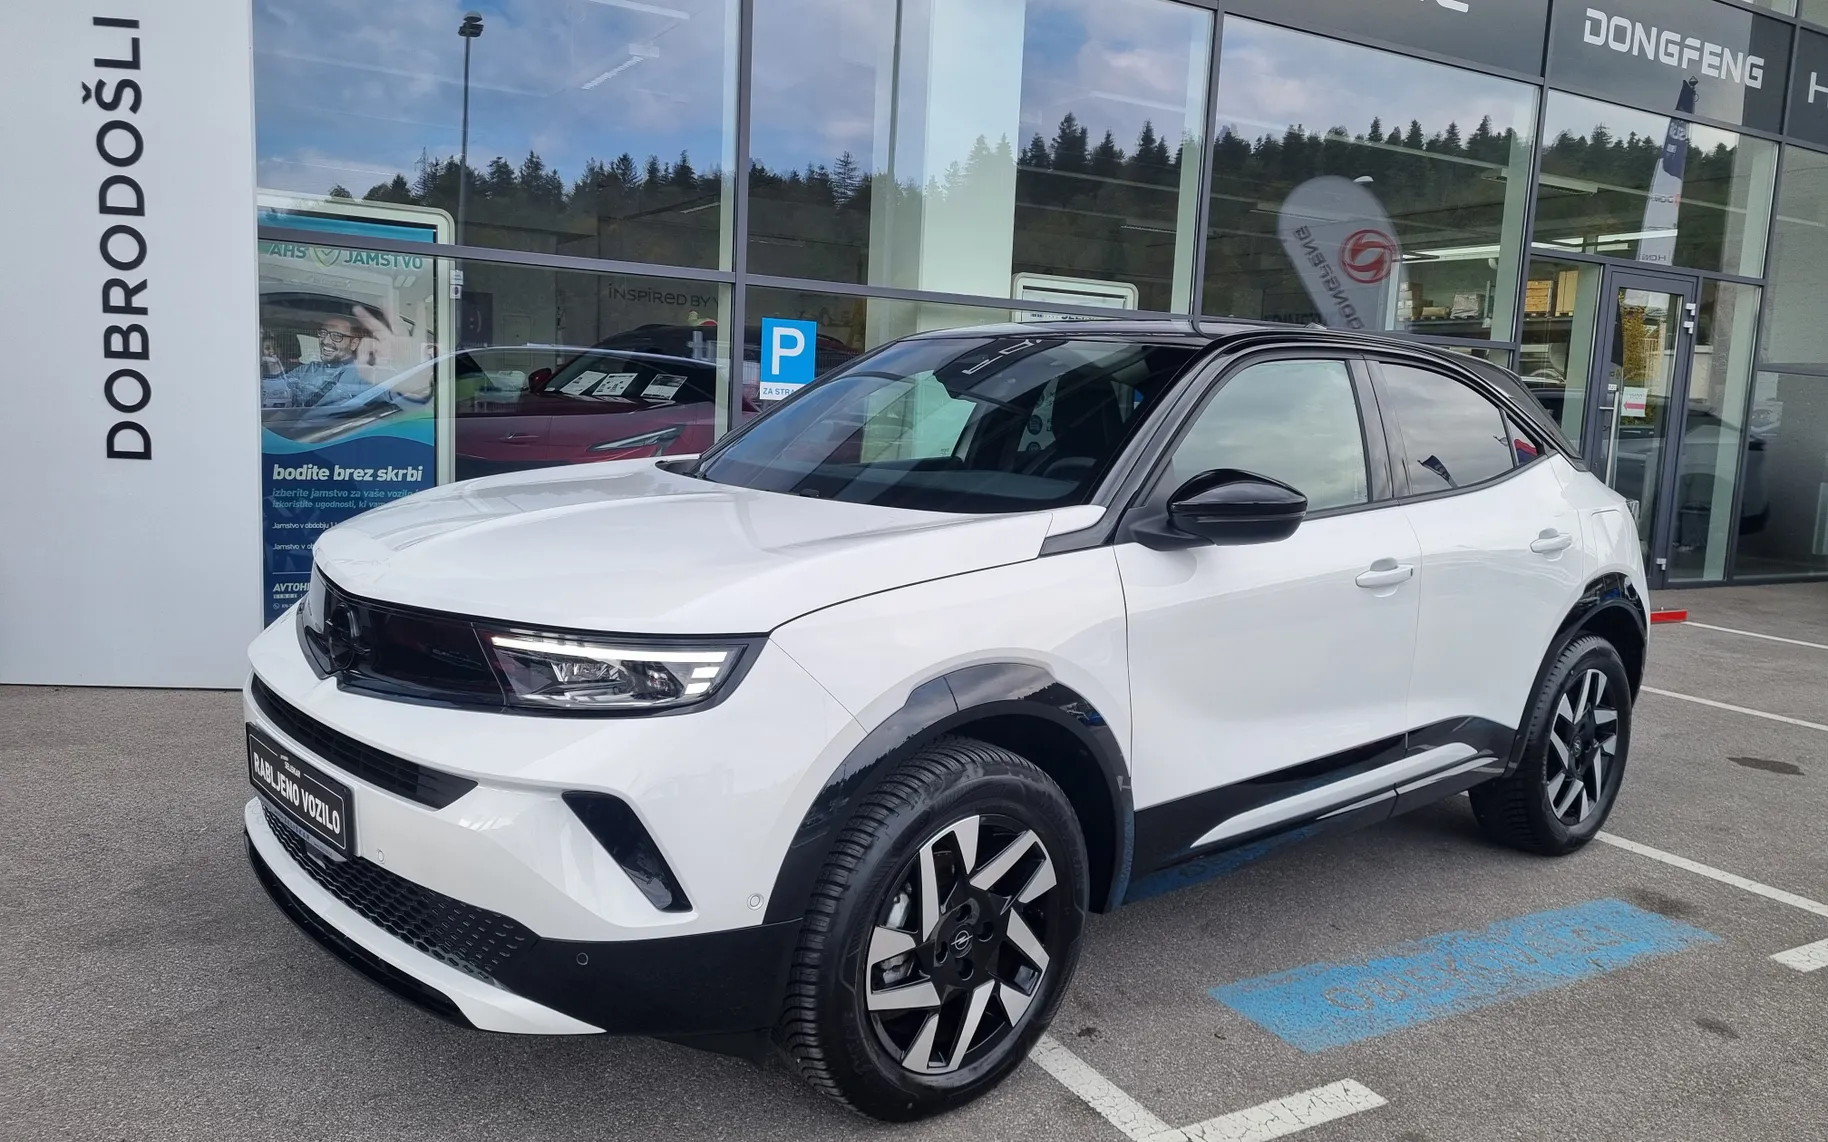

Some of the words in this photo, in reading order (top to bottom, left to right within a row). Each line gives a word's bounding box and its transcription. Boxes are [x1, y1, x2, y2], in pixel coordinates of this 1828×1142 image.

[1584, 8, 1764, 89] DONGFENG
[81, 16, 153, 461] DOBRODOŠLI
[269, 243, 307, 259] AHS
[344, 251, 423, 270] JAMSTVO
[690, 295, 711, 308] BY
[771, 326, 805, 375] P
[762, 387, 774, 396] ZA
[272, 463, 330, 481] bodite
[333, 464, 374, 481] brez
[376, 465, 424, 482] skrbi
[272, 488, 309, 498] izberite
[310, 488, 348, 499] jamstvo
[350, 490, 361, 498] za
[363, 488, 385, 498] vaše
[315, 500, 357, 509] ugodnosti,
[358, 500, 367, 508] ki
[272, 521, 300, 529] Jamstvo
[305, 521, 329, 531] obdobju
[253, 751, 300, 807] RABLJENO
[301, 788, 340, 835] VOZILO
